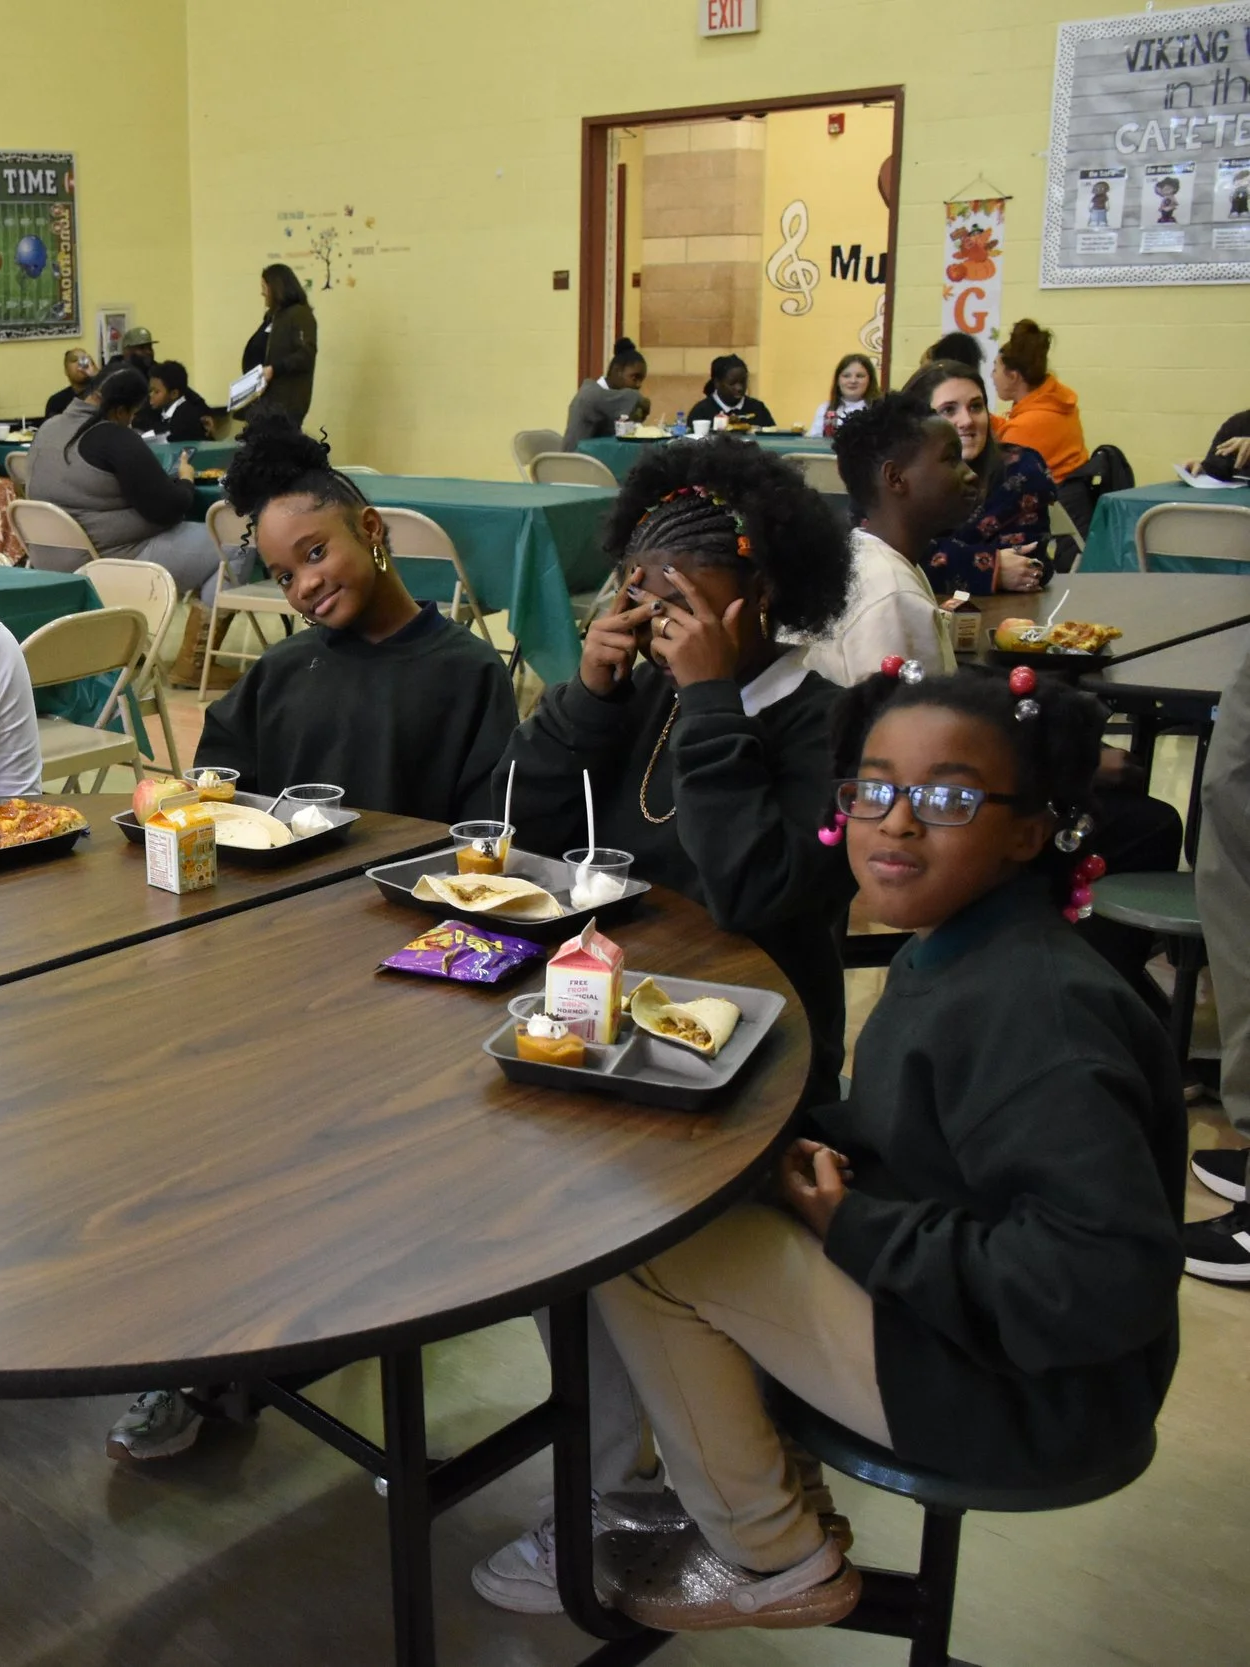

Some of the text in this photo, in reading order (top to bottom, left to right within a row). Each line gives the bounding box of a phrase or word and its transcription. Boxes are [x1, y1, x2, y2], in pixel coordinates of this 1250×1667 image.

[708, 0, 742, 30] EXIT
[1125, 30, 1230, 73] VIKING
[1164, 67, 1250, 110] in th
[2, 168, 57, 195] TIME
[830, 244, 888, 285] Mu
[953, 286, 989, 334] G
[567, 986, 588, 994] FROM
